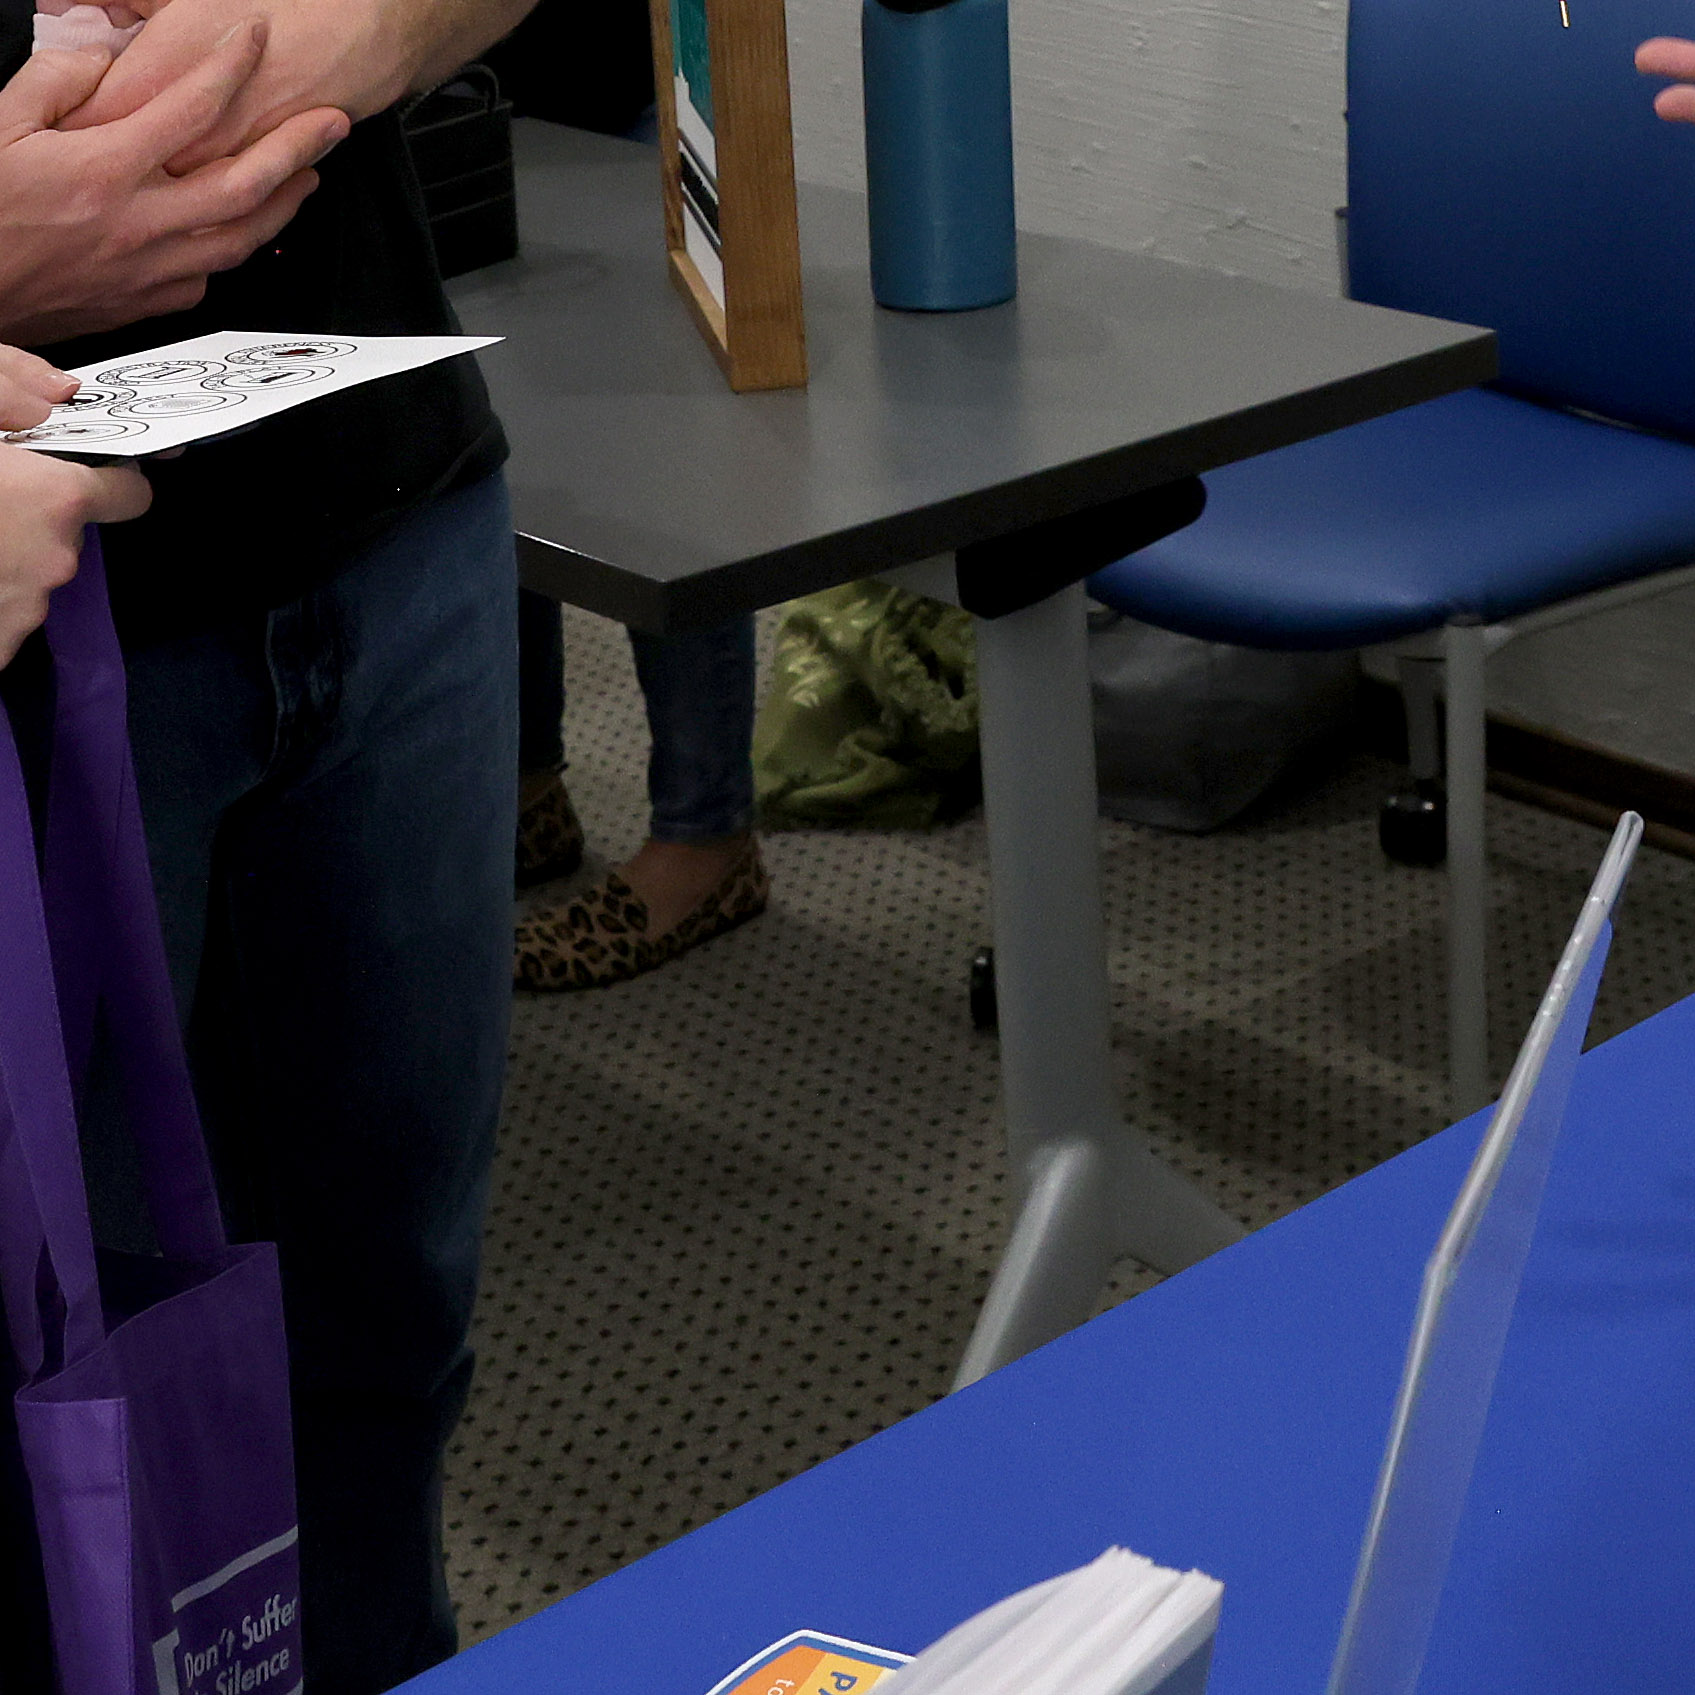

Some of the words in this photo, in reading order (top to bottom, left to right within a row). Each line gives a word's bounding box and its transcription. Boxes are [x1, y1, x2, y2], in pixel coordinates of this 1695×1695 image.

[184, 1627, 236, 1688] Don't
[241, 1593, 298, 1651] Suffer
[215, 1647, 290, 1695] Silence
